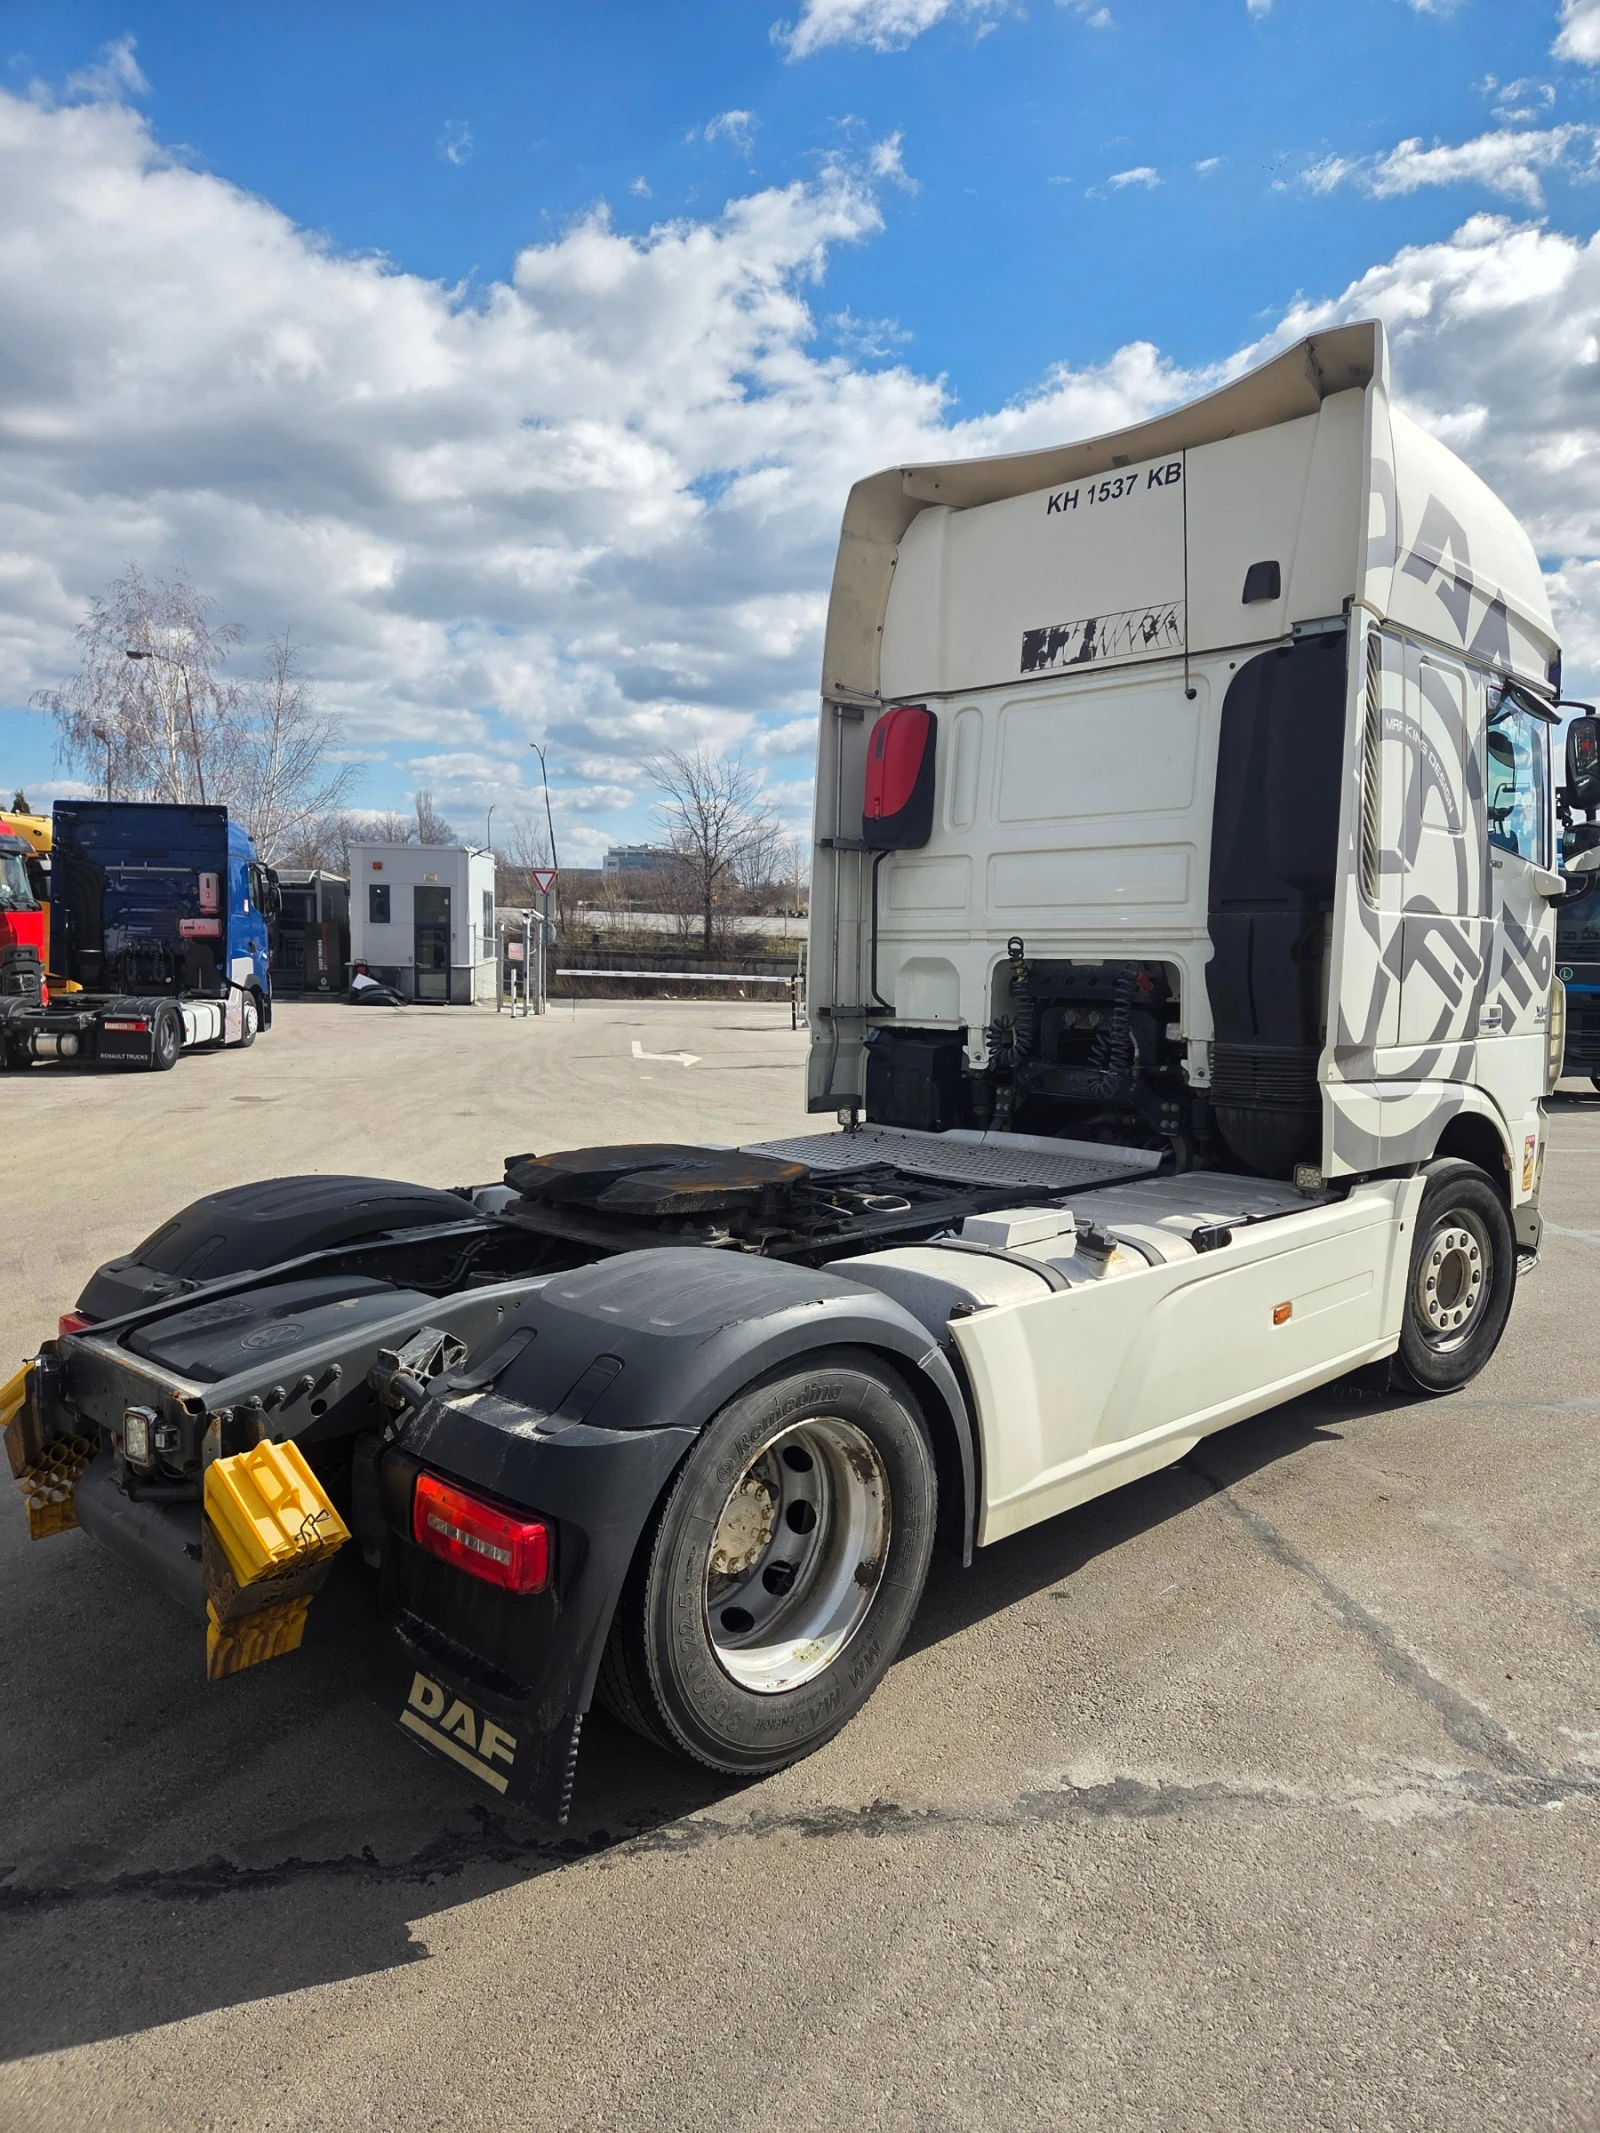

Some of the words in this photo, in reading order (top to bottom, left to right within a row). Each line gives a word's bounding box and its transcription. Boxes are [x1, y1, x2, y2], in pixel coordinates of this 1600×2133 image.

[1047, 488, 1080, 515] KH
[1087, 473, 1139, 505] 1537
[1147, 462, 1182, 489] KB
[1428, 752, 1454, 814] DESIGN
[407, 1671, 517, 1765] DAF
